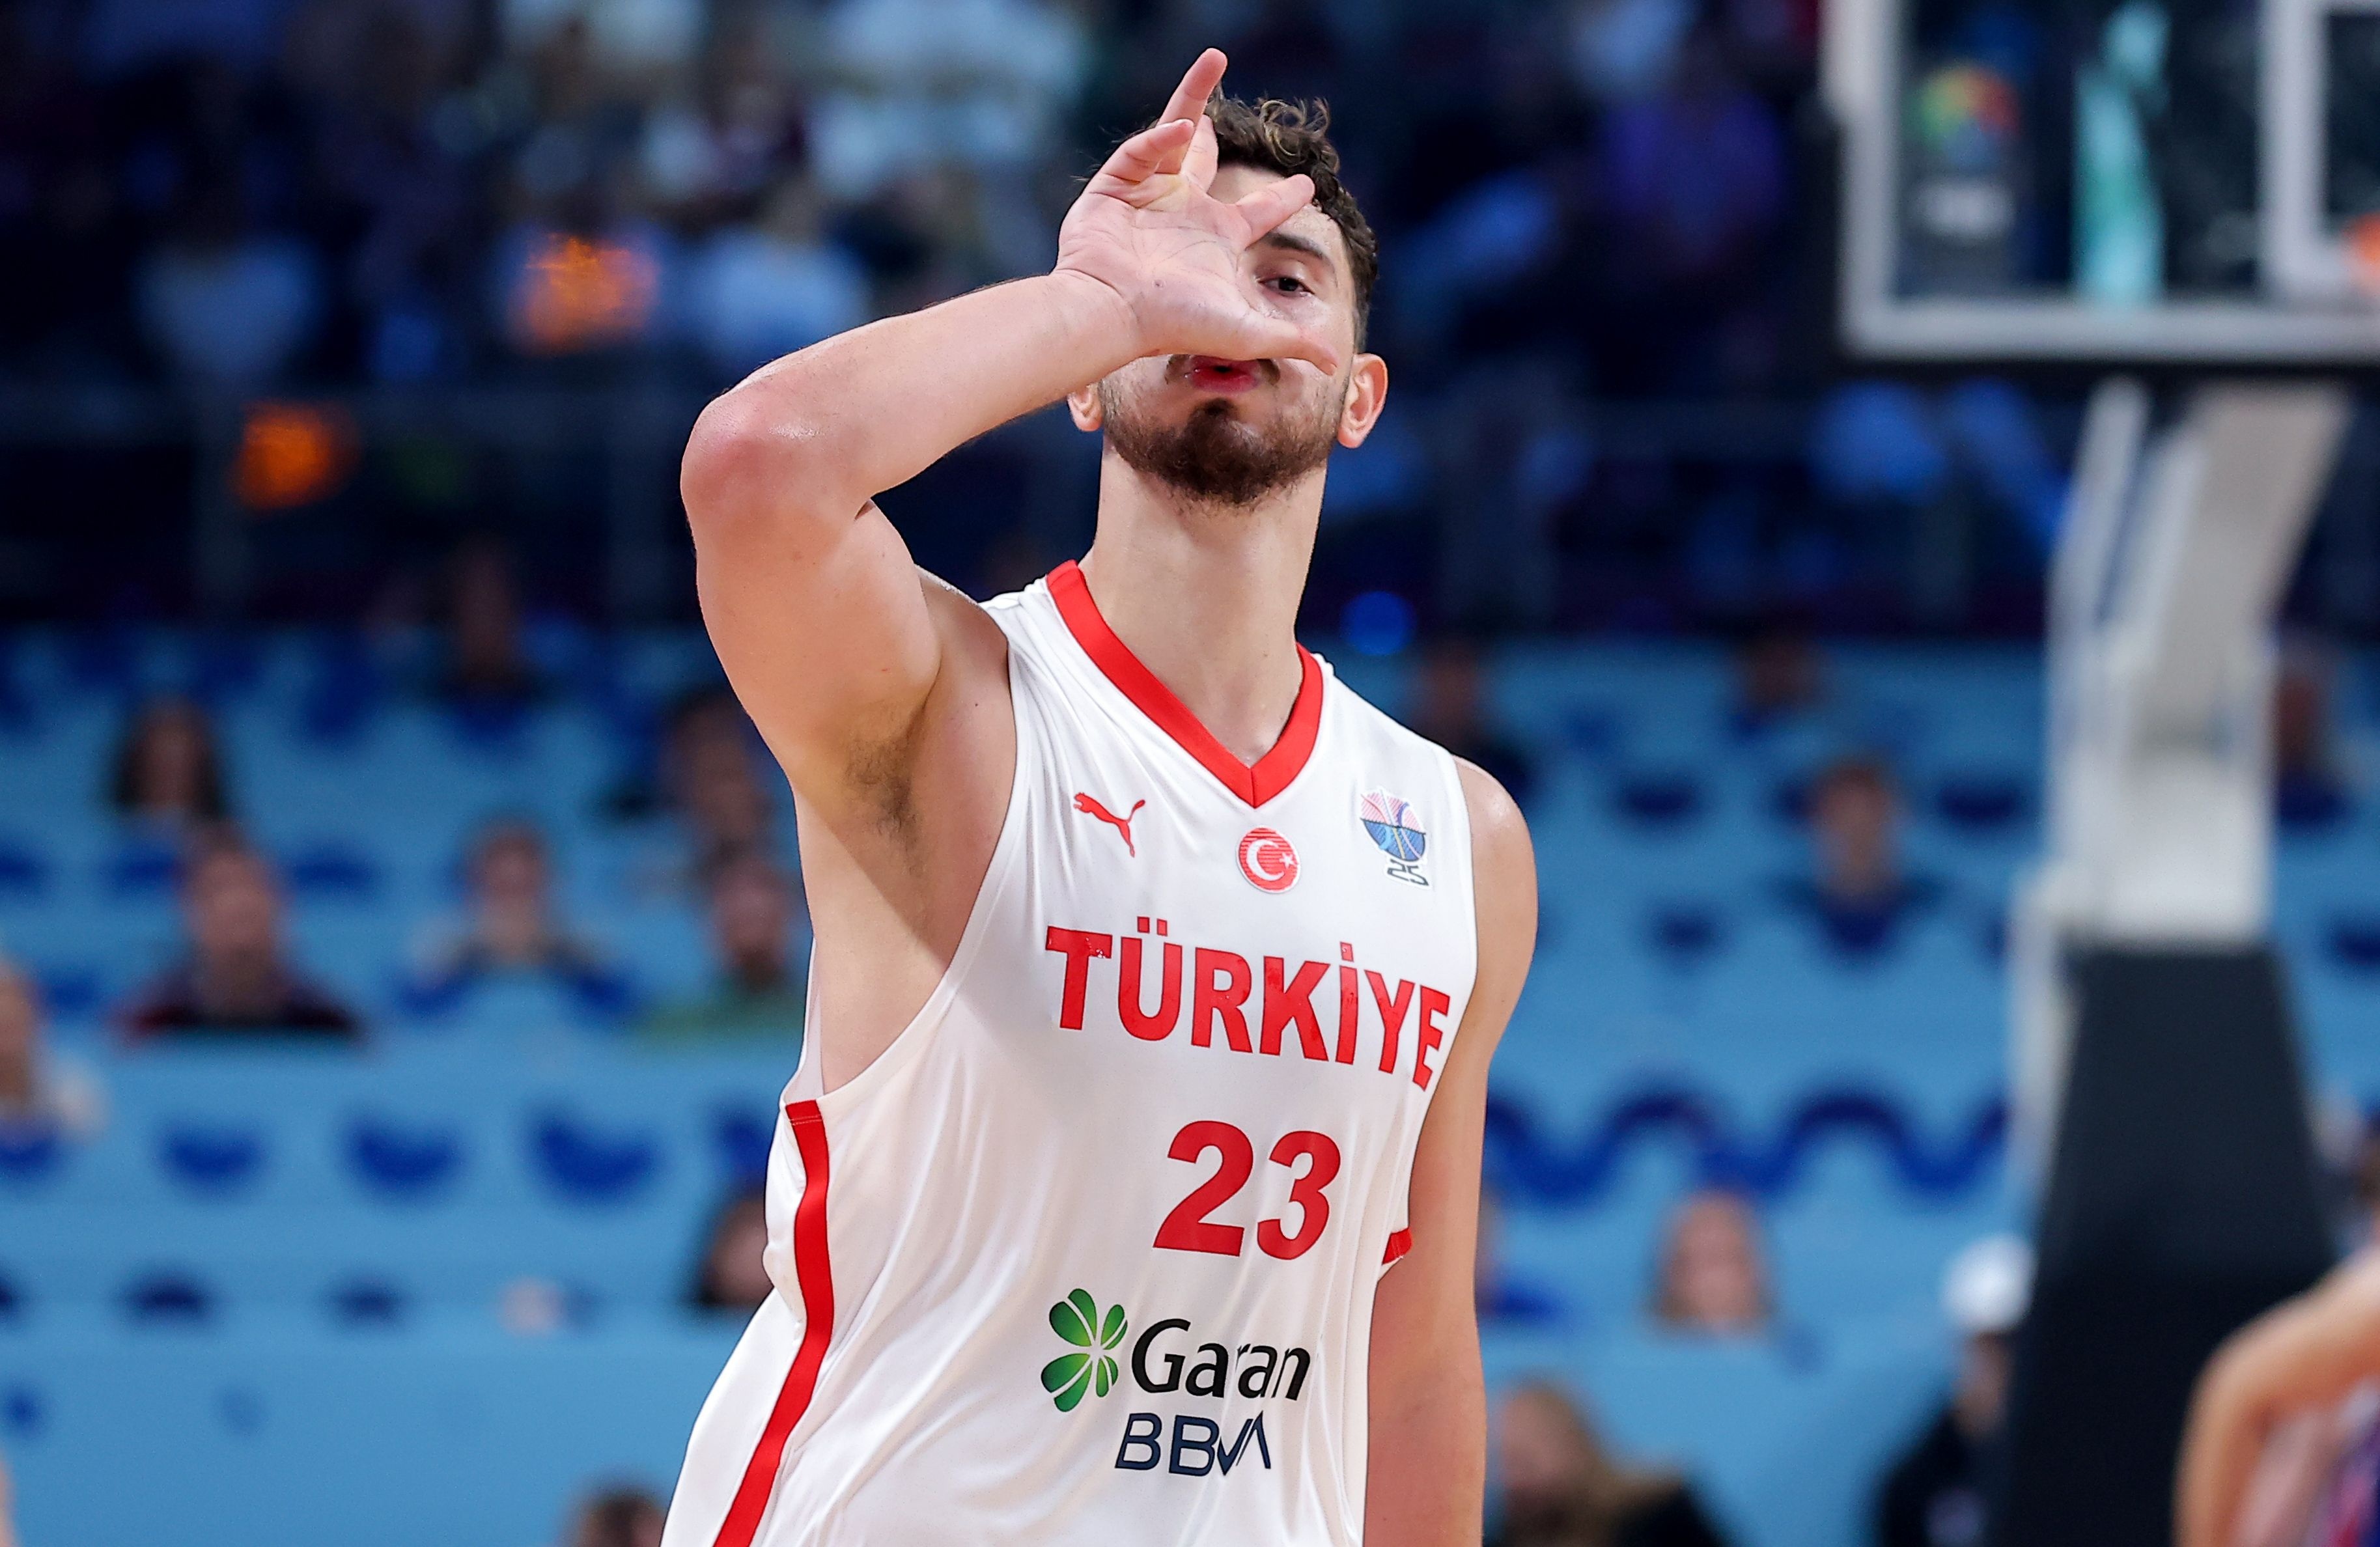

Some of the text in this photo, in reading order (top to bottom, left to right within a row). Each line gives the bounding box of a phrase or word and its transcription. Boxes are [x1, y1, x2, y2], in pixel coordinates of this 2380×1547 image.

[1045, 915, 1451, 1092] TÜRKİYE
[1153, 1120, 1341, 1261] 23
[1131, 1318, 1311, 1401] Garan
[1114, 1410, 1272, 1477] BBVA
